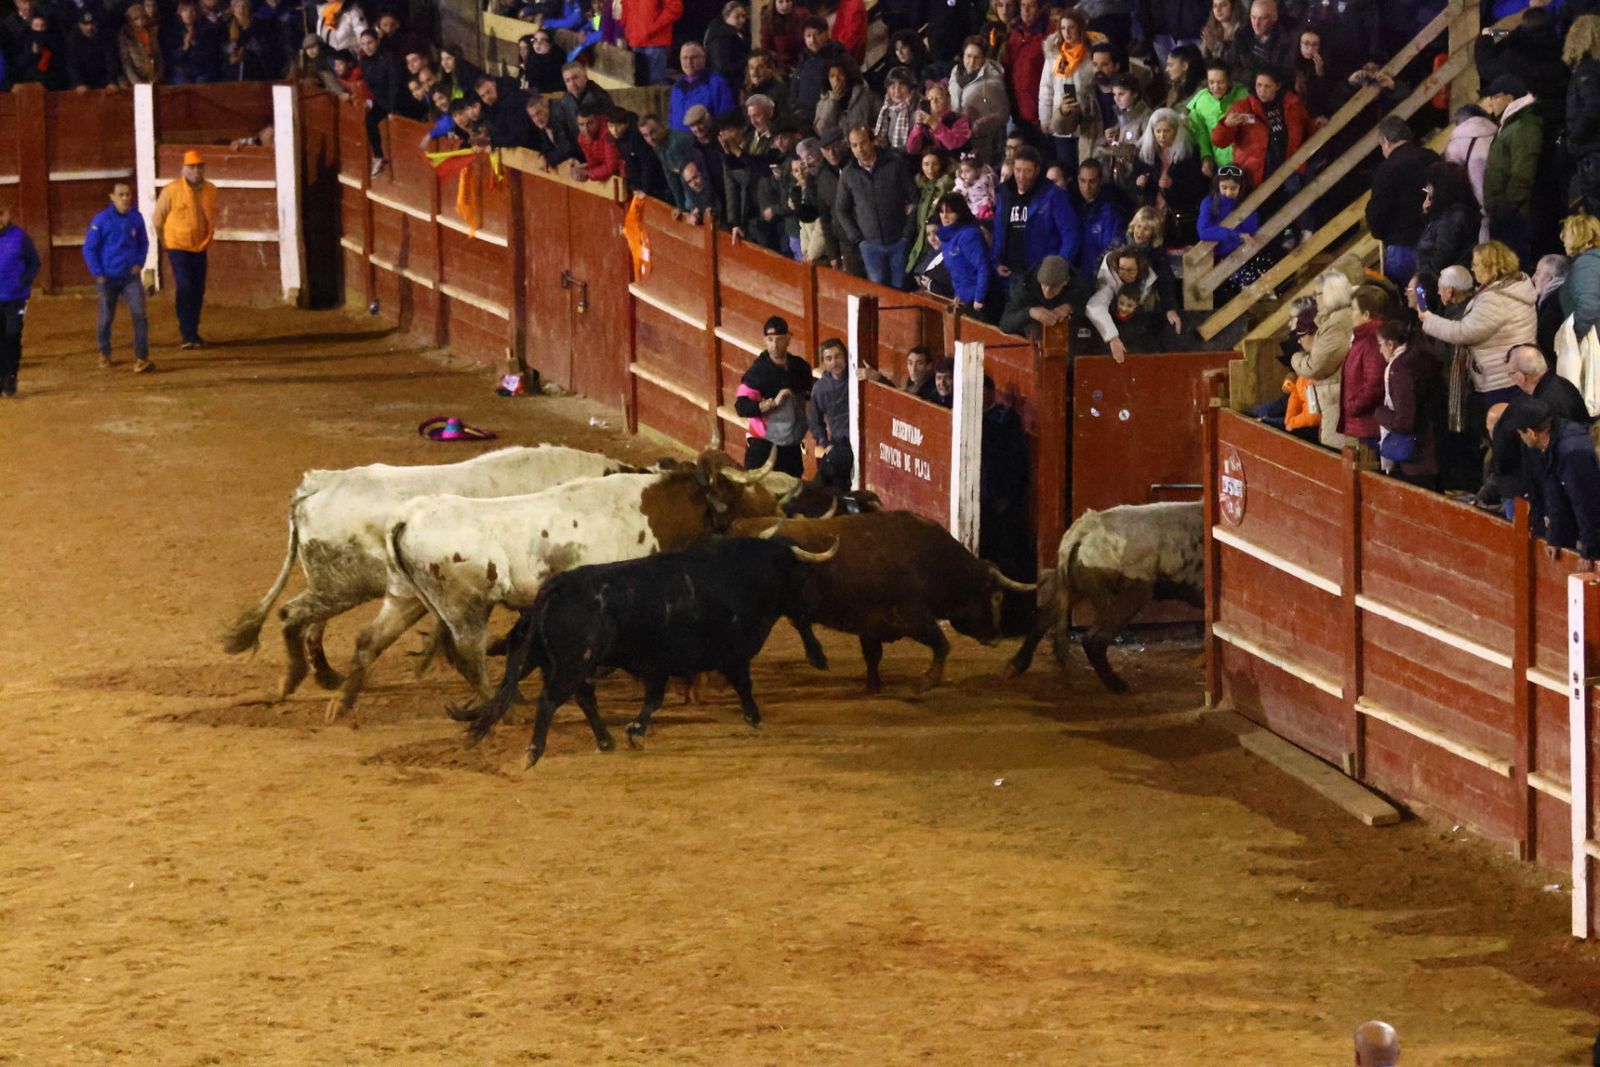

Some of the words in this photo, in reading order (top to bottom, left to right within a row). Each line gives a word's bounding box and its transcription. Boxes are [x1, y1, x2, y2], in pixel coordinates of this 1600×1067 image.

[879, 442, 901, 469] SERVICIO
[904, 453, 911, 473] DE
[914, 457, 931, 481] PLAZA
